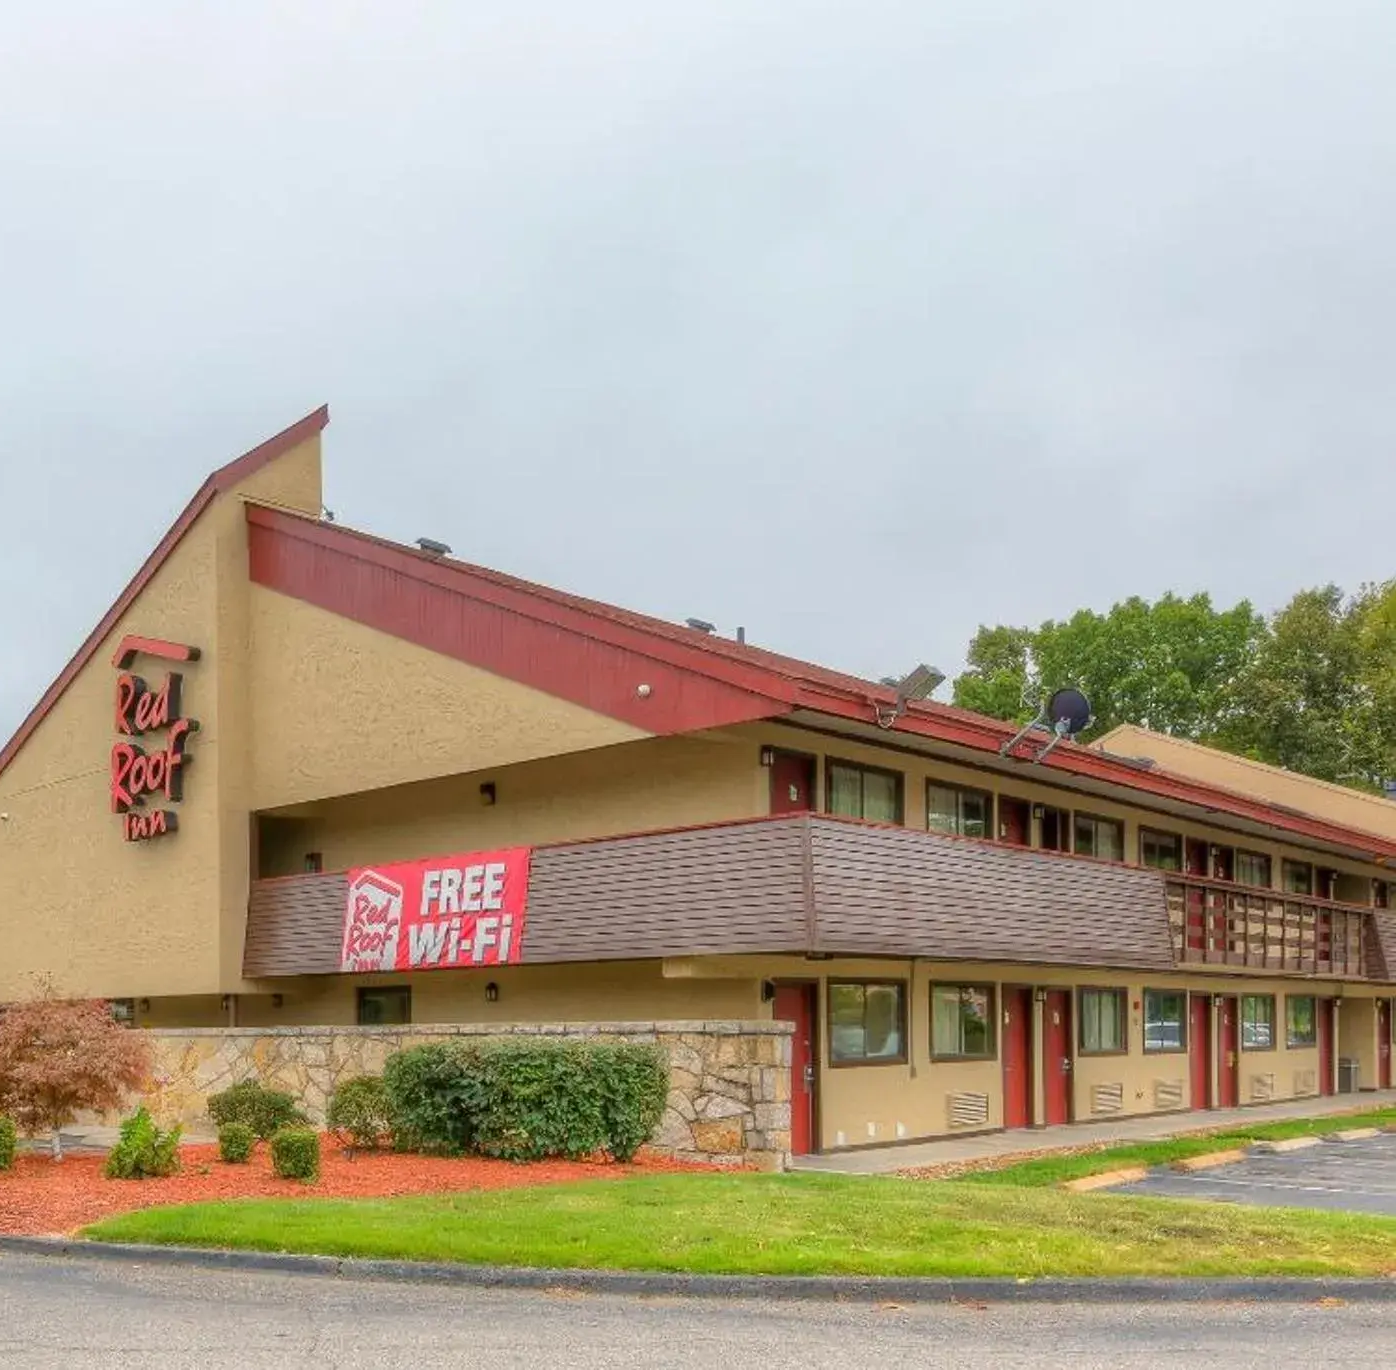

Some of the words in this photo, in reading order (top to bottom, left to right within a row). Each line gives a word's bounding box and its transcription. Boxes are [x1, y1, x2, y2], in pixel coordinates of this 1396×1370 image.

[117, 672, 183, 735] Red
[112, 719, 200, 813] Roof
[124, 809, 178, 841] Inn
[353, 893, 392, 928] Red
[420, 862, 506, 917] FREE
[347, 917, 400, 956] Roof
[408, 913, 513, 966] Wi-Fi
